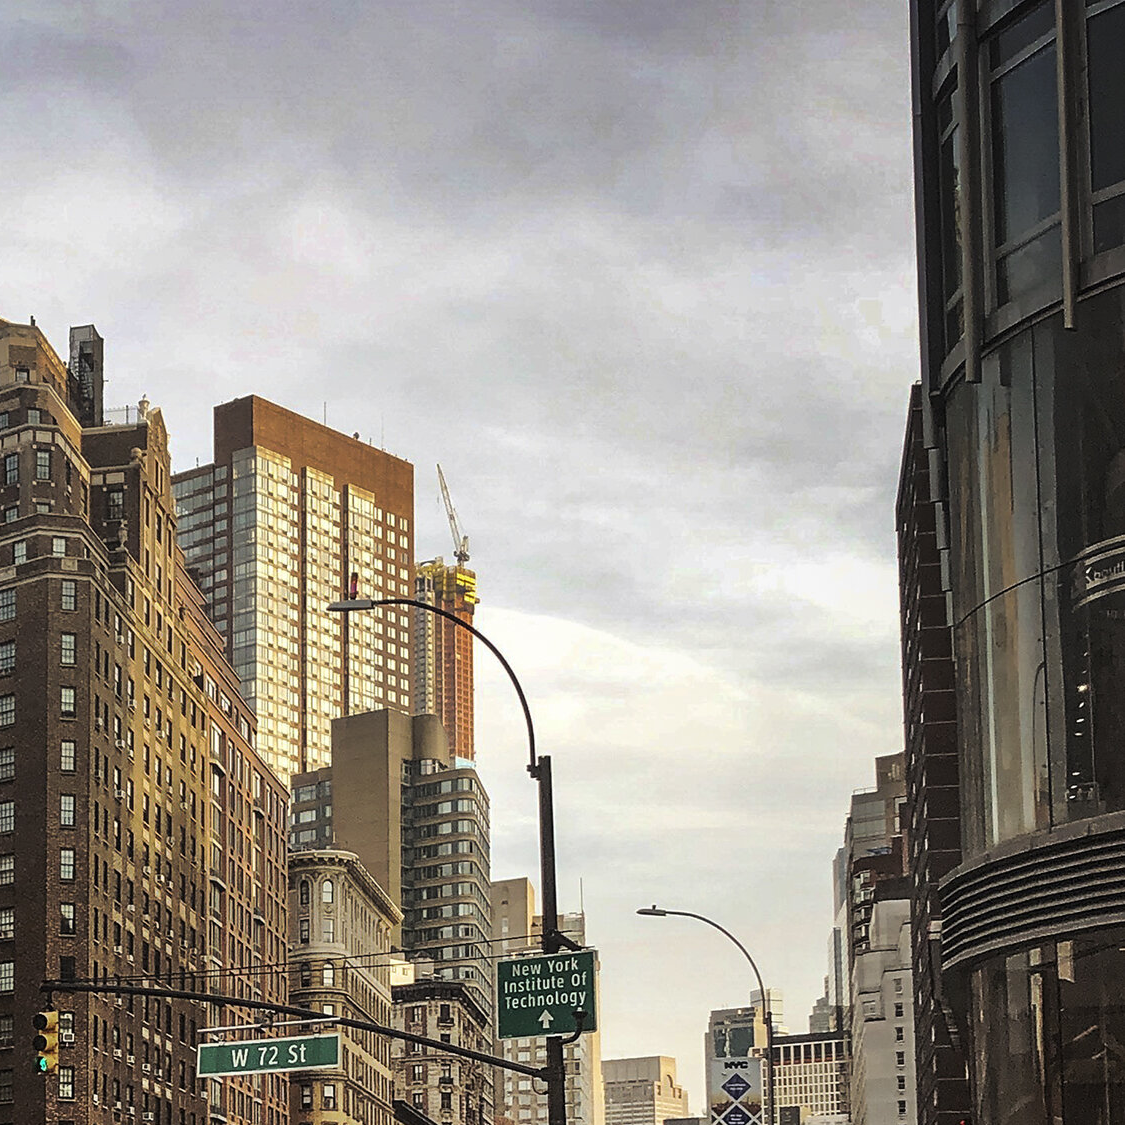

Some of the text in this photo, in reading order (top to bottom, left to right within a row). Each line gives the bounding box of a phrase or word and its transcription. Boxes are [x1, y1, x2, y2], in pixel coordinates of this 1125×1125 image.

[512, 957, 579, 977] New York
[504, 971, 587, 994] Institute Of
[505, 990, 586, 1010] Technology
[231, 1043, 307, 1068] W 72 St
[724, 1061, 749, 1069] NYC
